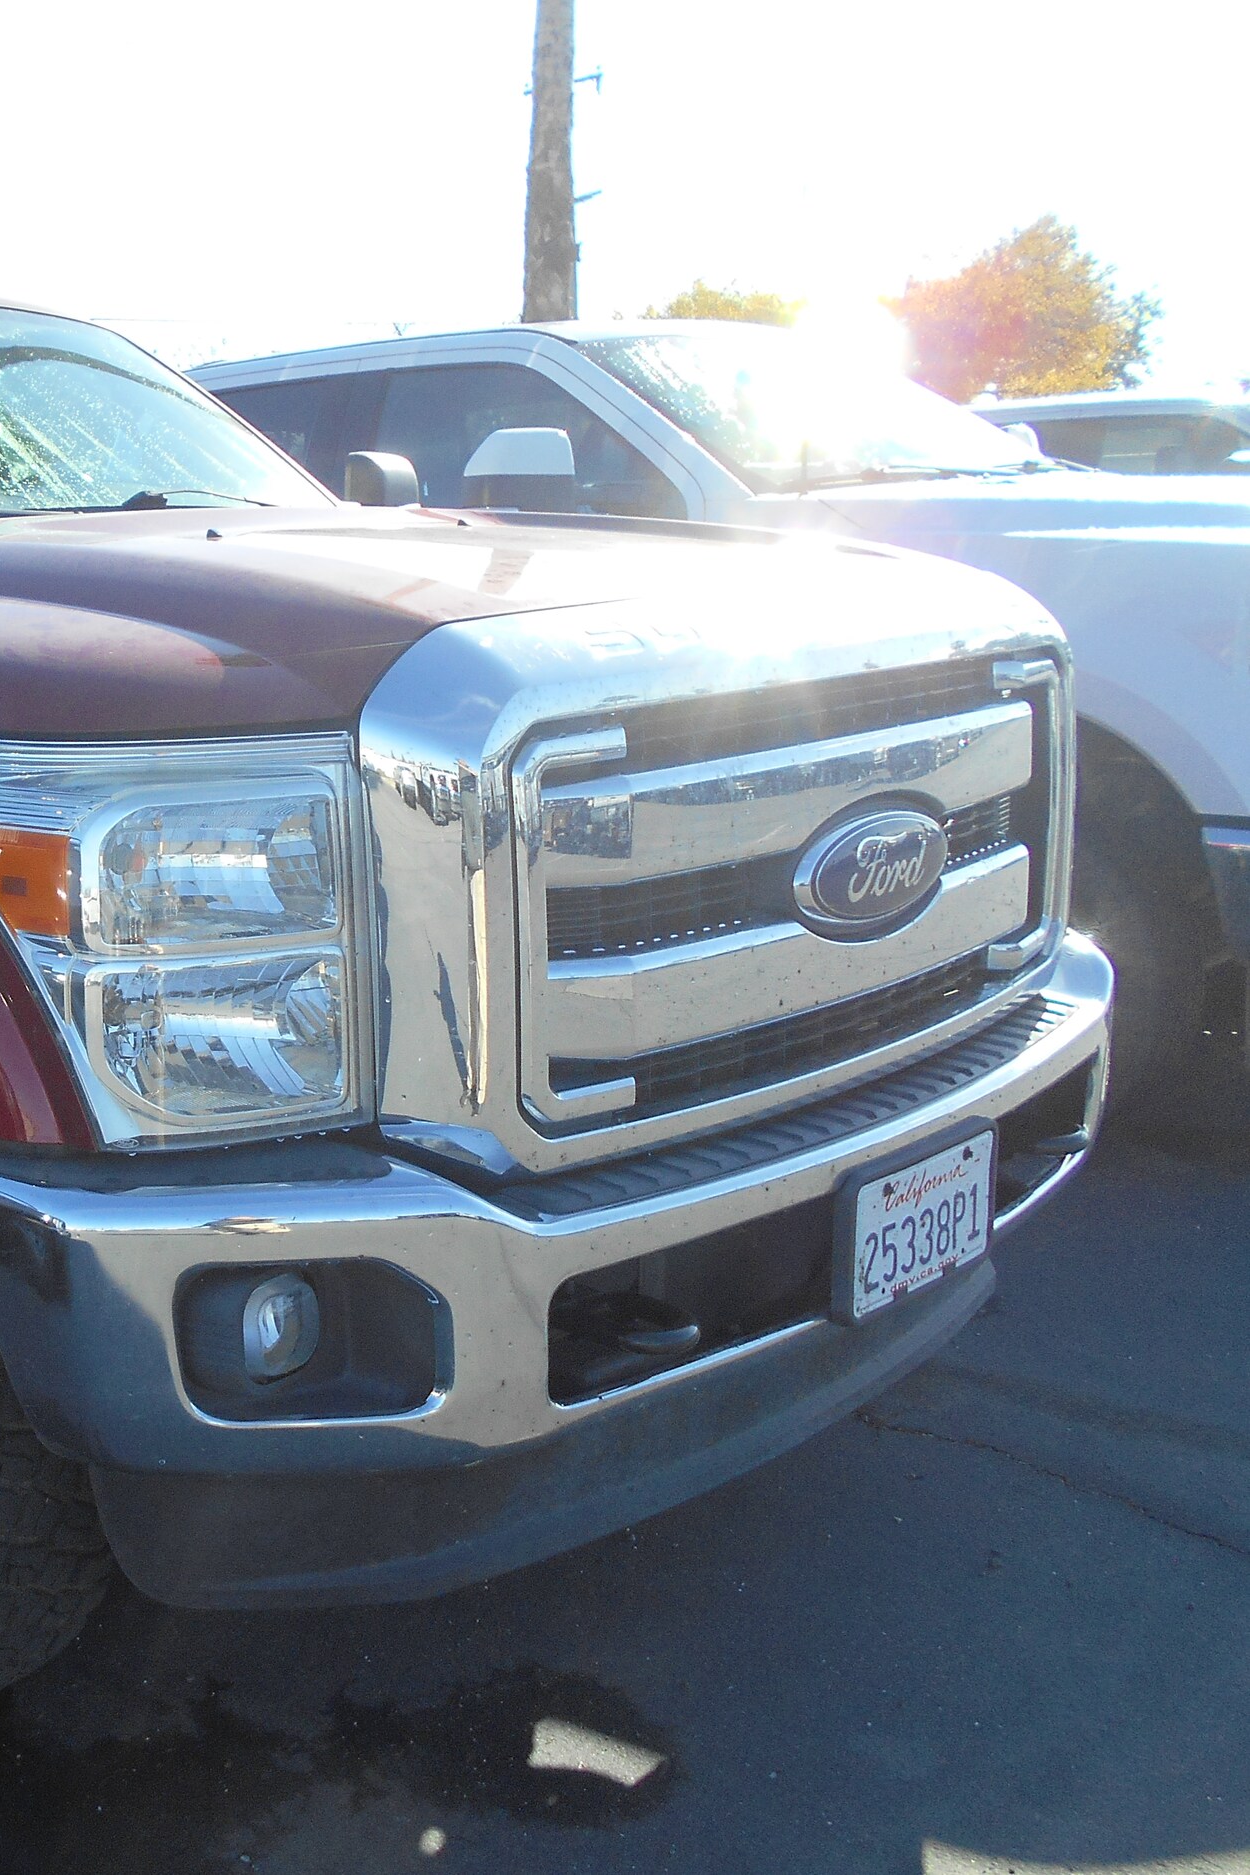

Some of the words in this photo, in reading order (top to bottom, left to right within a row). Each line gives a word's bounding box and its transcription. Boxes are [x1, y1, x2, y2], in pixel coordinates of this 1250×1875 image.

[847, 831, 927, 902] Ford
[884, 1164, 968, 1212] California
[863, 1182, 981, 1294] 25338P1
[890, 1253, 959, 1293] dmv.ca.gov
